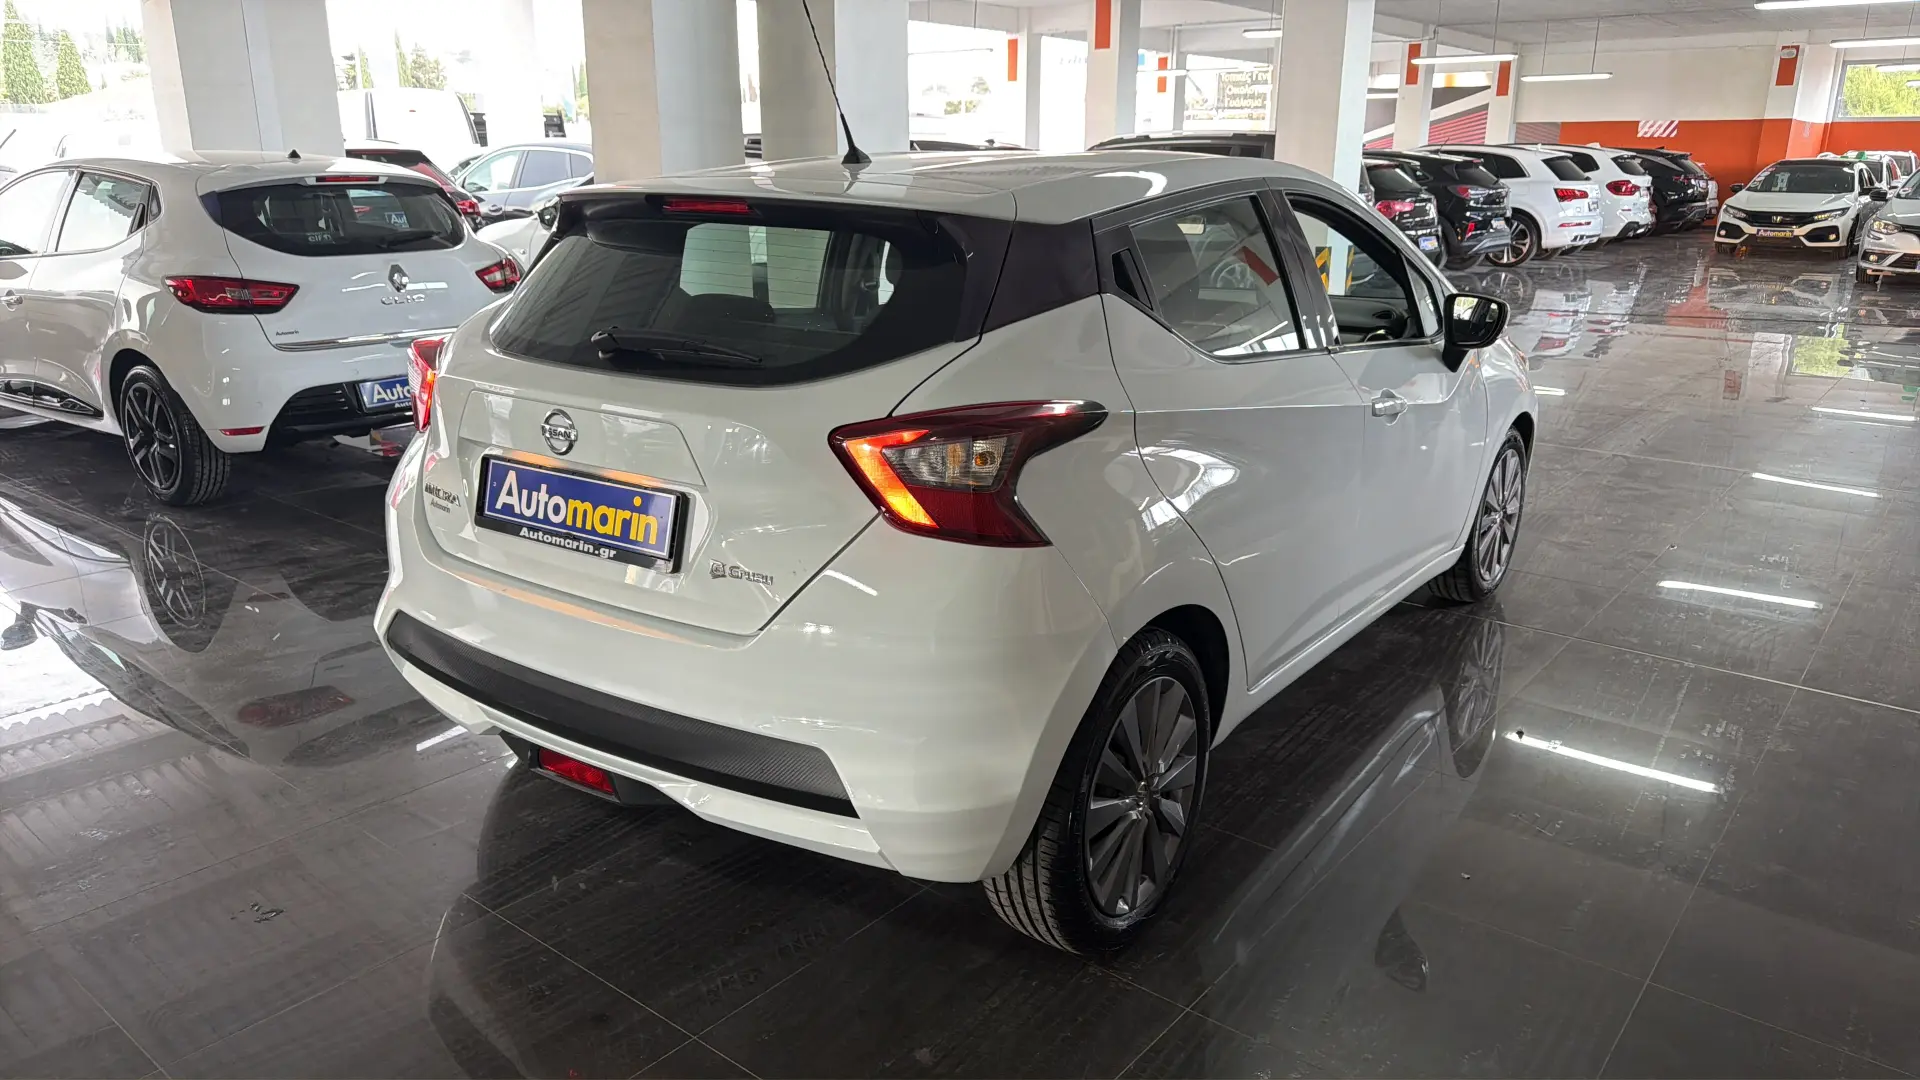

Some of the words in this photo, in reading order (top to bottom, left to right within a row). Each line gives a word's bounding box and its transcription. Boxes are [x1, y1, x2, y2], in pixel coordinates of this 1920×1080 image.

[1758, 229, 1792, 237] Automarin
[381, 293, 425, 305] CLIO
[425, 482, 461, 507] MICRA
[430, 498, 451, 514] Automarin
[495, 470, 658, 545] Automarin
[519, 526, 617, 558] Automarin.gr
[728, 565, 774, 586] Gruau
